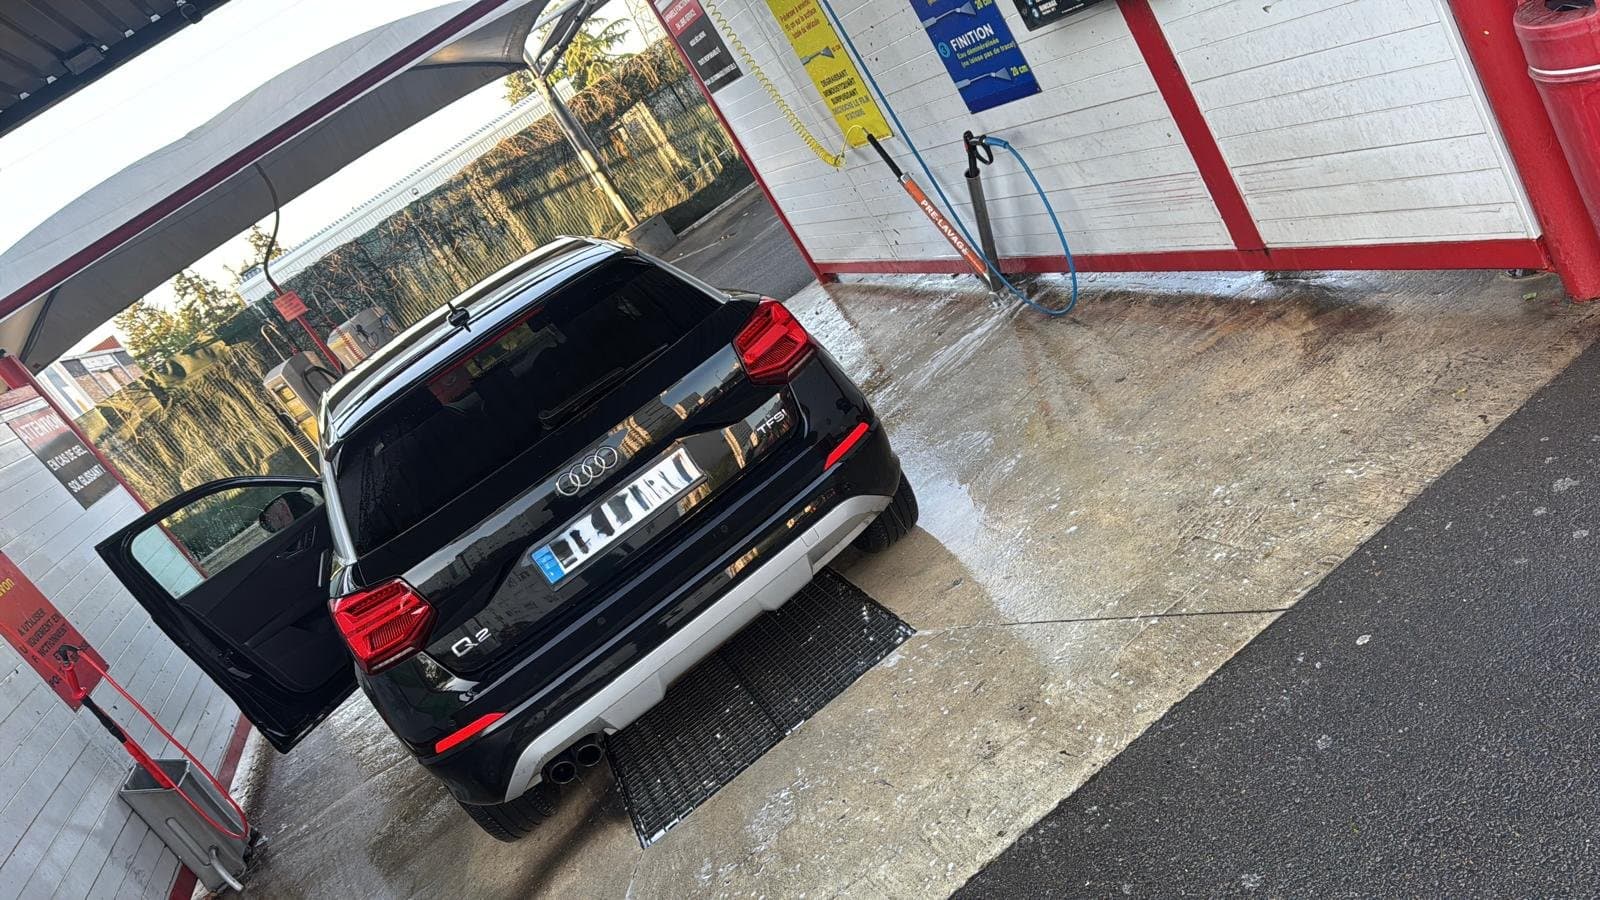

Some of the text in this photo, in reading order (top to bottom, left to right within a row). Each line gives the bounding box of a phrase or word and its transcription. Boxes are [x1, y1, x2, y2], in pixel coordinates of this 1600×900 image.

[950, 23, 994, 52] FINITION
[1010, 64, 1029, 77] 20 cm
[920, 199, 969, 256] PRE-LAVAGE
[16, 411, 66, 443] ATTENTION
[756, 409, 788, 434] TFSI
[46, 458, 60, 471] EN
[55, 453, 70, 467] CAS
[65, 449, 78, 461] DE
[67, 479, 84, 493] SOL
[19, 616, 54, 654] UIQUEMENT
[451, 627, 492, 657] Q2
